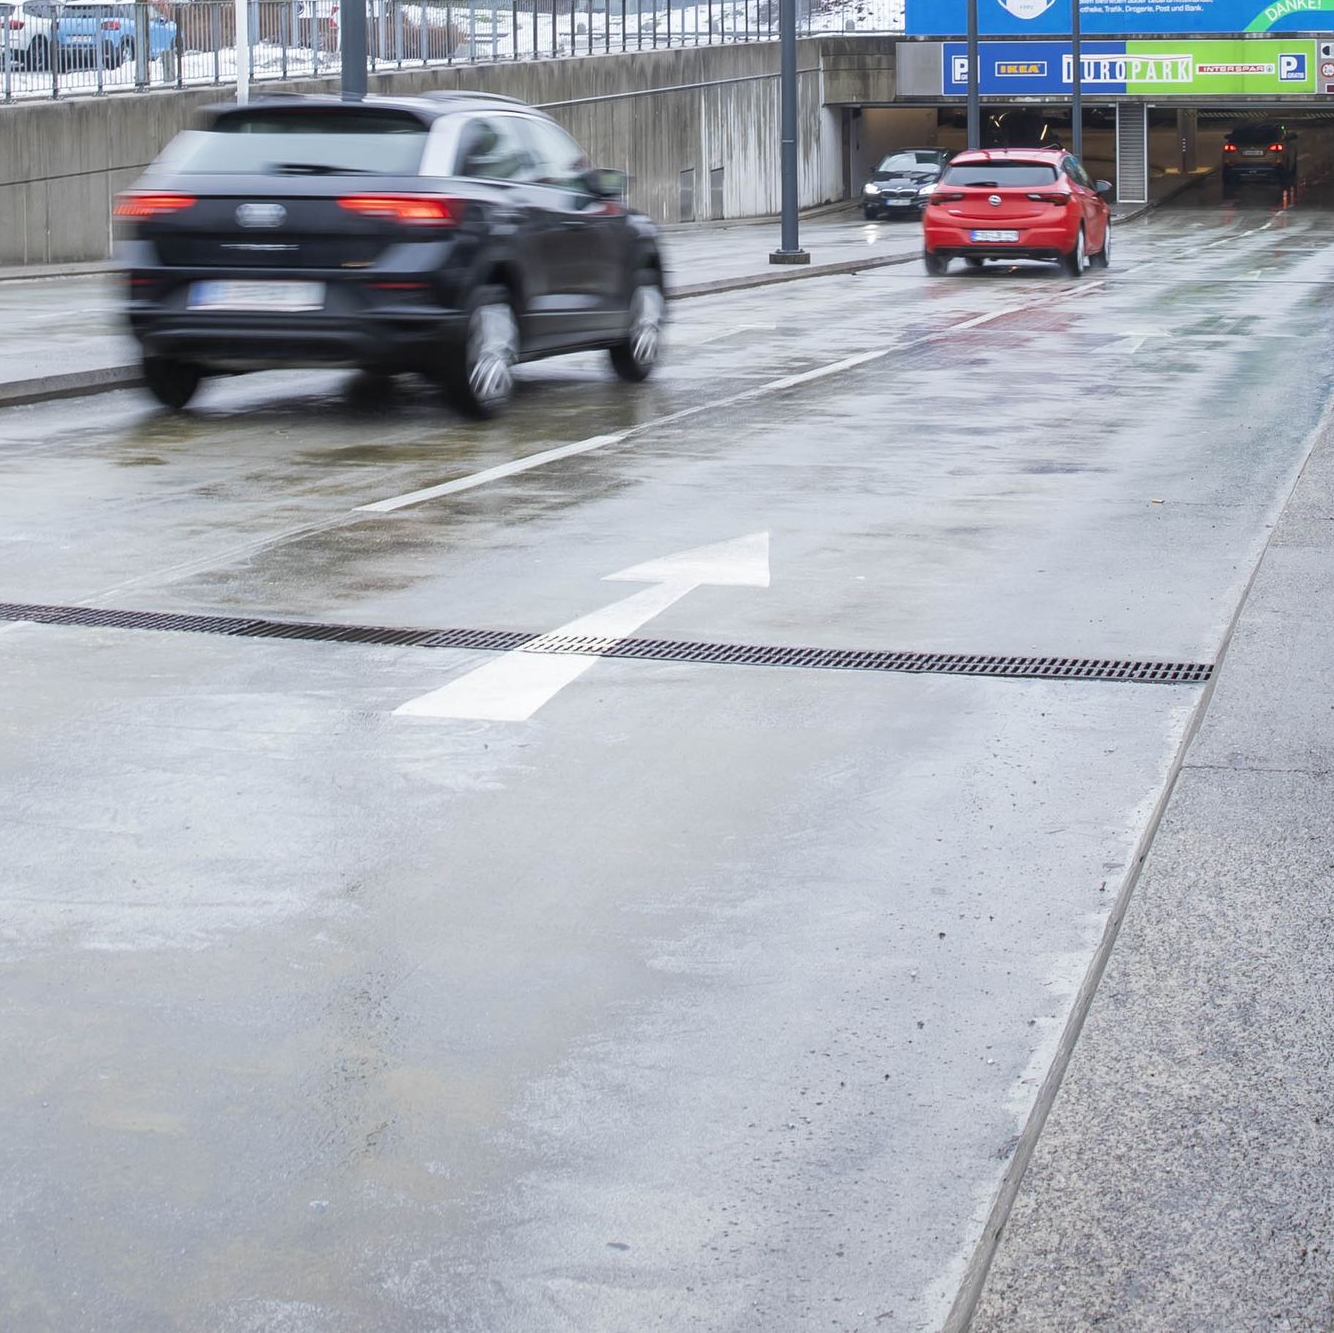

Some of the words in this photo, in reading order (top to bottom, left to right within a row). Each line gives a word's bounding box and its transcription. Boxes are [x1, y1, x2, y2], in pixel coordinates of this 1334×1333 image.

[1155, 4, 1170, 12] Post
[1000, 64, 1040, 73] IKEA
[1280, 56, 1298, 78] P
